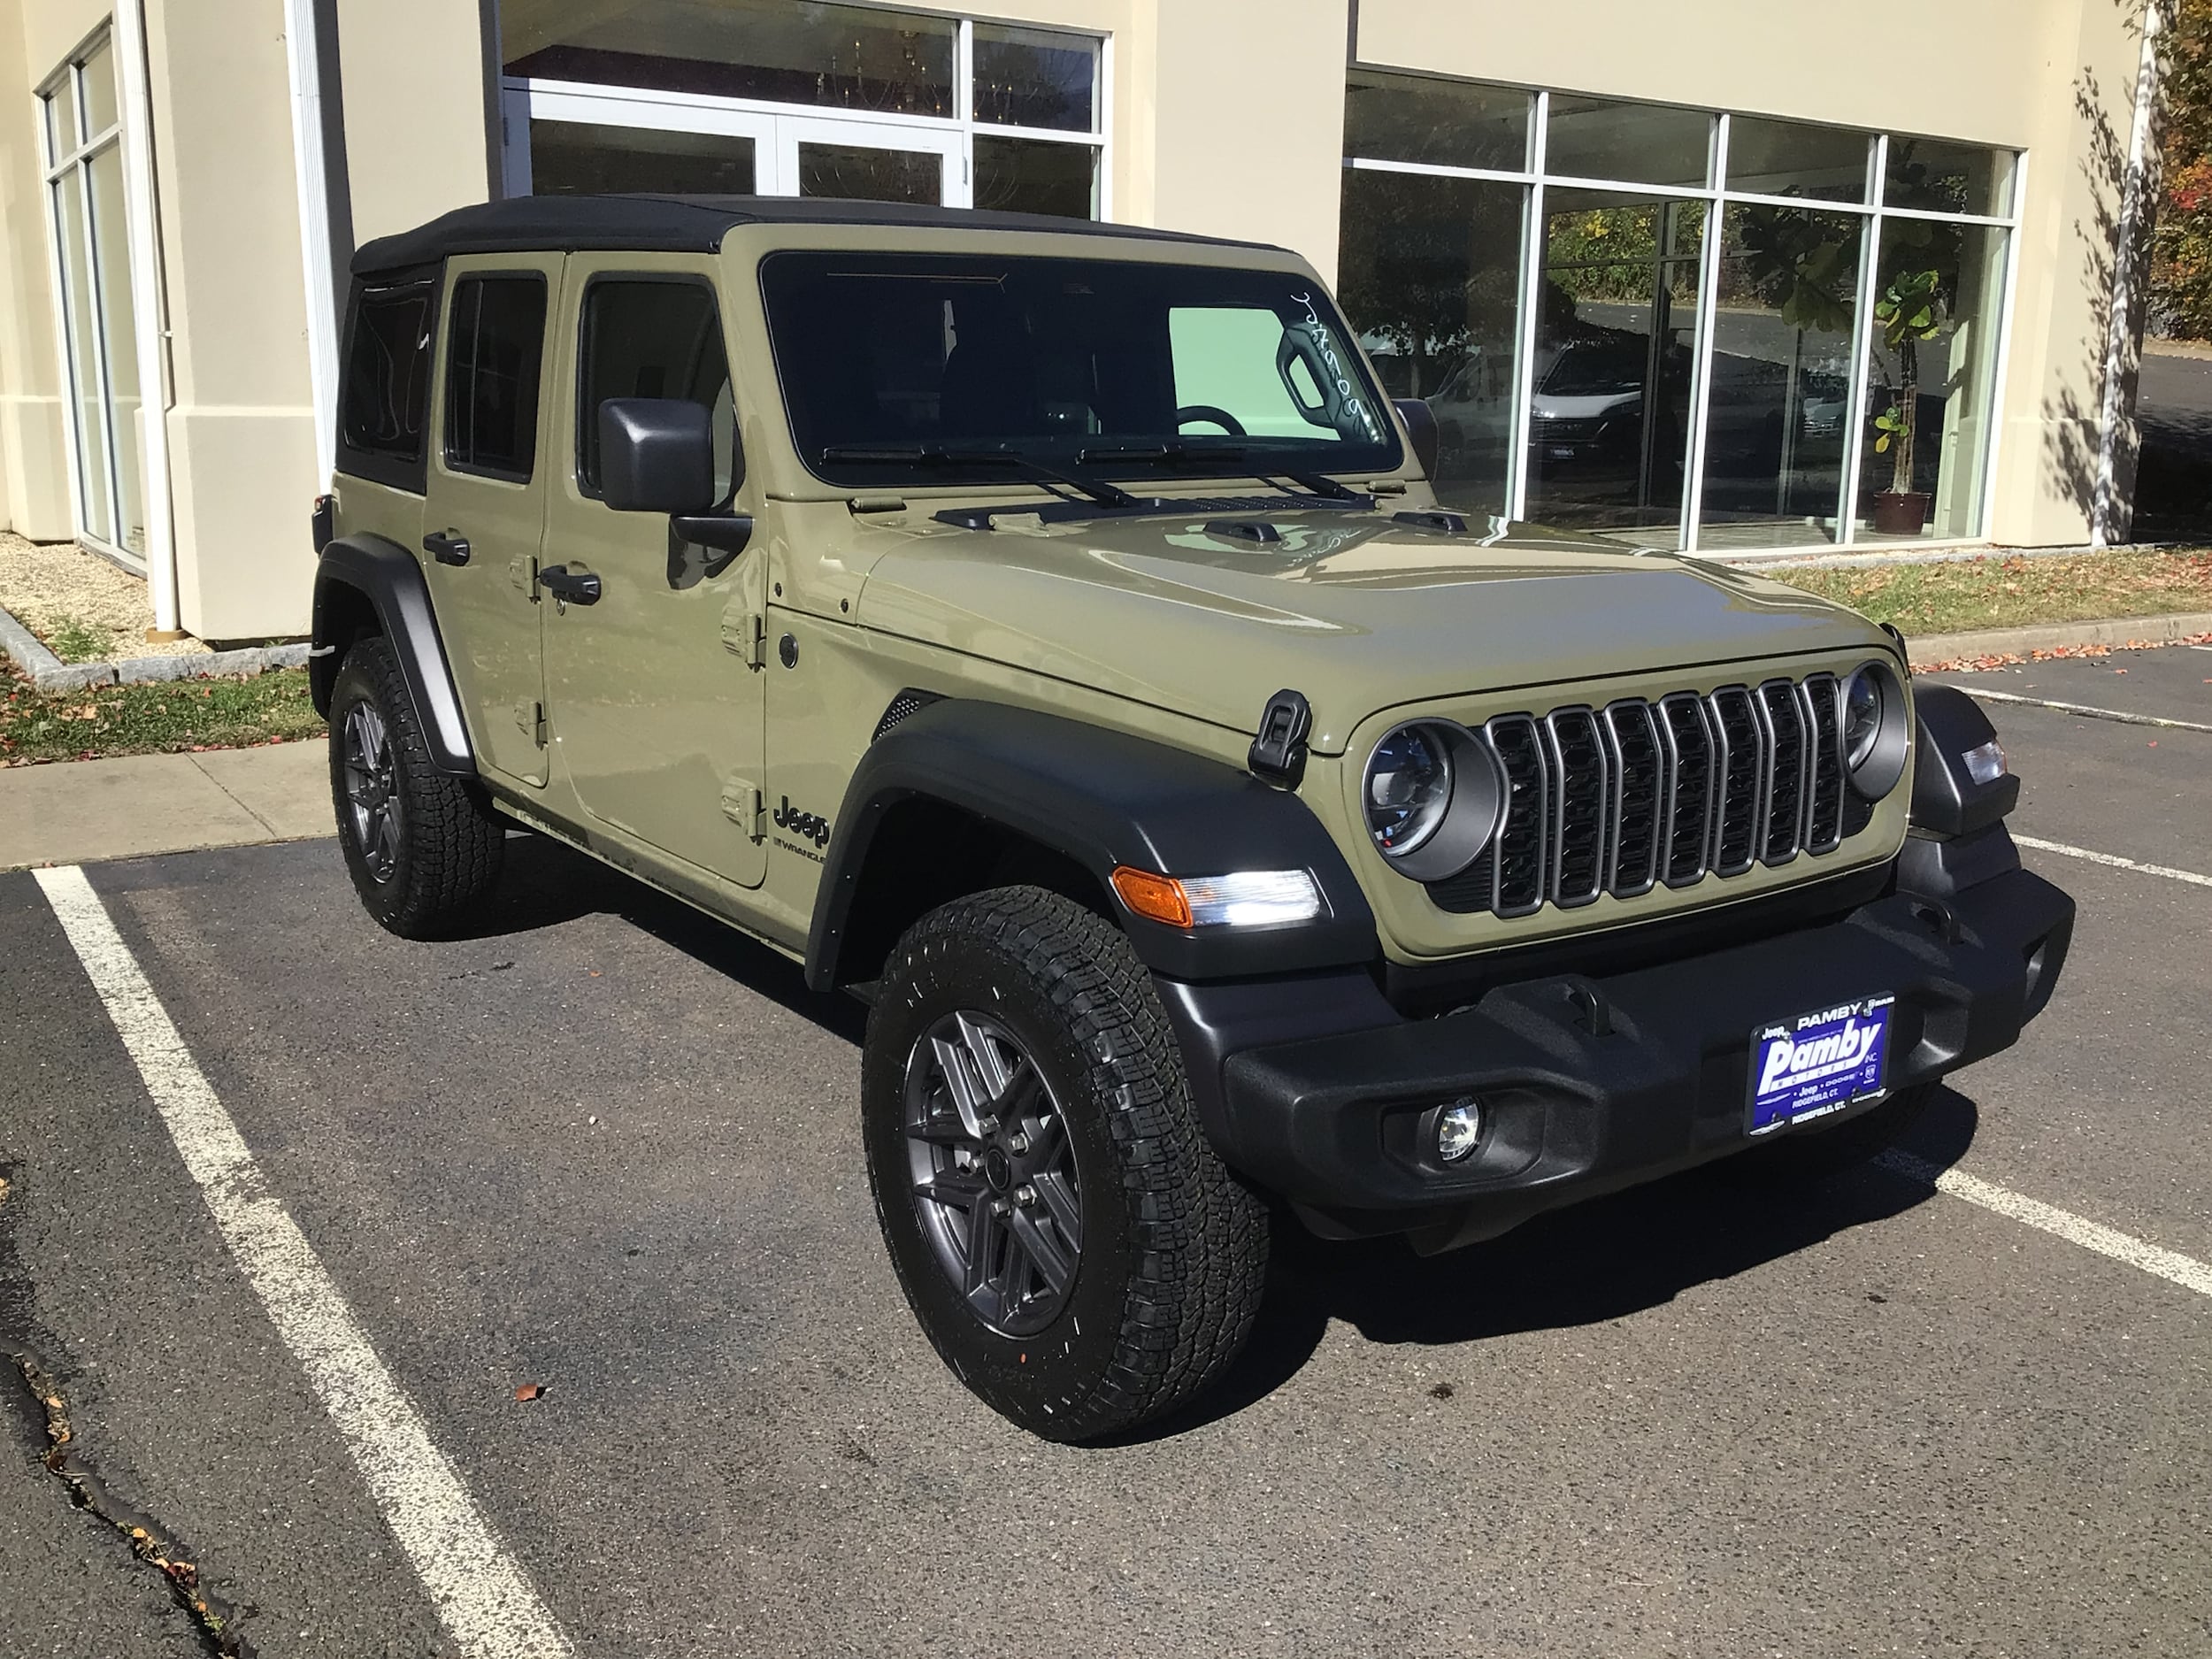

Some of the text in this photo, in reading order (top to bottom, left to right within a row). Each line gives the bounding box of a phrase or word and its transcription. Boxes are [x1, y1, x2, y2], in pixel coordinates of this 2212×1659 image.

[773, 795, 830, 849] Jeep
[782, 840, 827, 864] WRANGLE
[1797, 1002, 1862, 1031] PAMBY
[1757, 1018, 1882, 1096] Pamby
